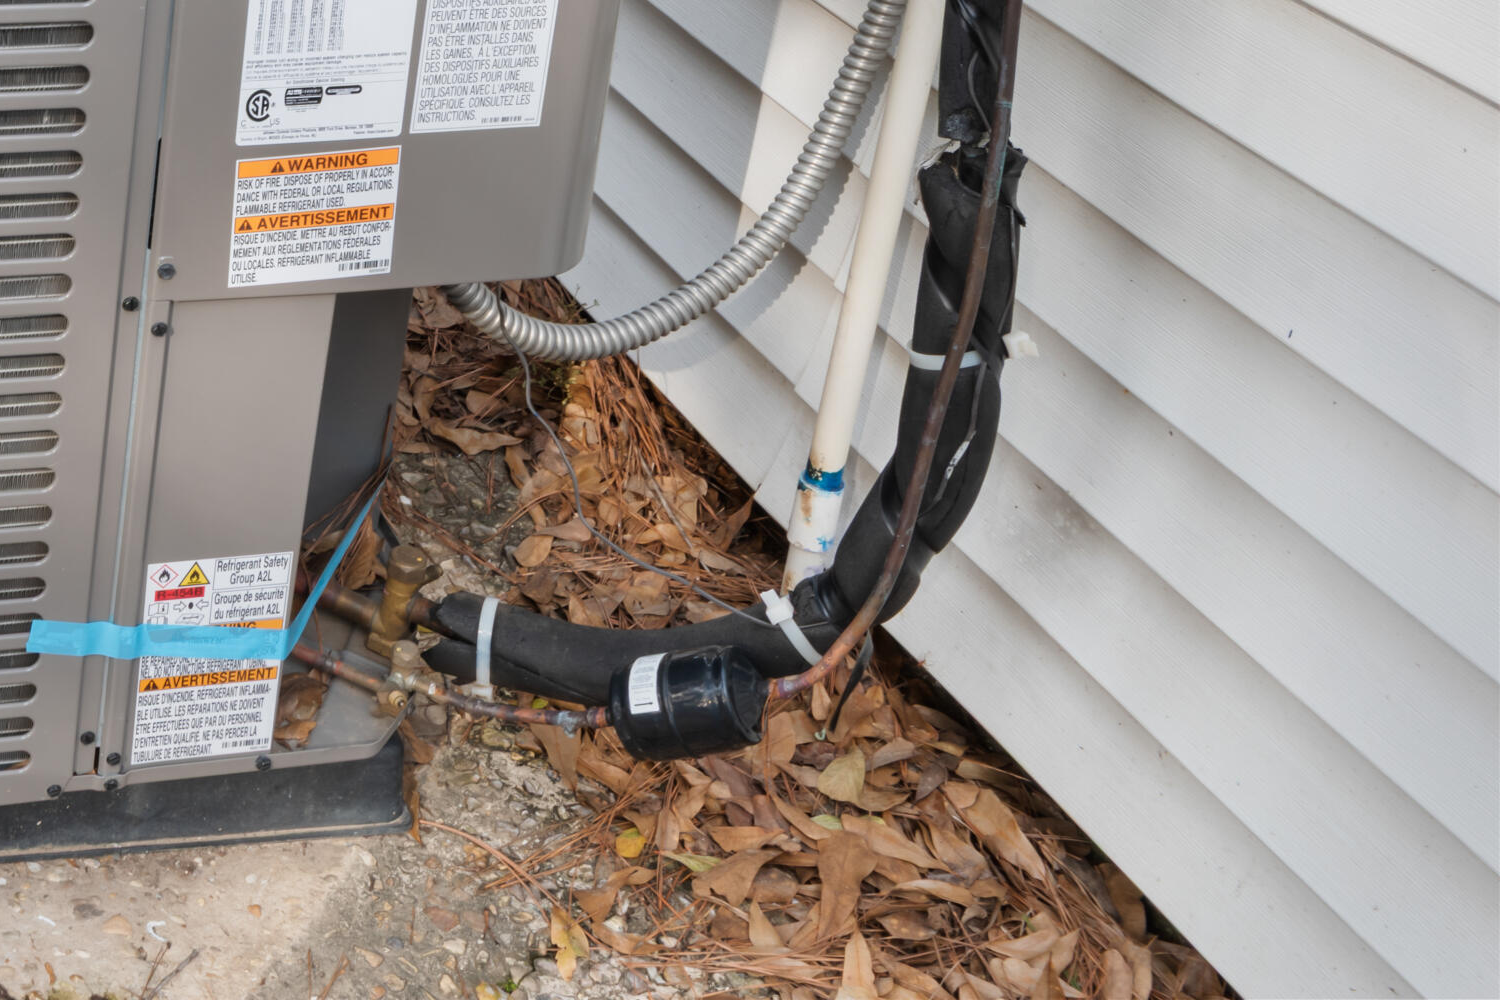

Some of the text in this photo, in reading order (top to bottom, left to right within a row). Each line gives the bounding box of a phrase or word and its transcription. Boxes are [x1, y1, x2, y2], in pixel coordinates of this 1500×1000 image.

[431, 10, 468, 22] PEUVENT
[491, 8, 508, 19] DES
[509, 6, 547, 18] SOURCES
[500, 20, 512, 31] NE
[513, 19, 547, 30] DOIVENT
[427, 36, 443, 47] PAS
[511, 32, 534, 43] DANS
[426, 49, 441, 60] LES
[424, 57, 540, 73] DES DISPOSITIFS AUXILIAIRES
[480, 71, 502, 83] POUR
[504, 70, 521, 81] UNE
[420, 86, 469, 98] UTILISATION
[470, 84, 490, 95] AVEC
[469, 96, 514, 108] CONSULTEZ
[515, 95, 531, 105] LES
[288, 153, 368, 172] WARNING
[237, 180, 253, 190] RISK
[255, 179, 265, 189] OF
[284, 174, 313, 186] DISPOSE
[314, 173, 324, 183] OF
[325, 170, 359, 182] PROPERLY
[361, 169, 368, 179] IN
[237, 192, 260, 203] DANCE
[262, 190, 278, 201] WITH
[280, 187, 310, 199] FEDERAL
[312, 186, 322, 196] OR
[323, 184, 345, 195] LOCAL
[236, 203, 277, 216] FLAMMABLE
[279, 198, 324, 212] REFRIGERANT
[257, 207, 390, 230] AVERTISSEMENT
[234, 234, 259, 246] RISQUE
[301, 228, 327, 240] METTRE
[329, 227, 338, 237] AU
[339, 225, 361, 236] REBUT
[233, 247, 261, 258] MEMENT
[263, 245, 276, 256] AUX
[232, 261, 242, 271] OU
[325, 250, 371, 263] INFLAMMABLE
[217, 554, 289, 575] Refrigerant Safety
[229, 570, 273, 588] Group A2L
[214, 592, 242, 608] Groupe
[244, 591, 253, 602] de
[215, 609, 224, 620] du
[267, 603, 281, 615] A2L
[163, 667, 273, 689] AVERTISSEMENT
[138, 694, 160, 707] RISQUE
